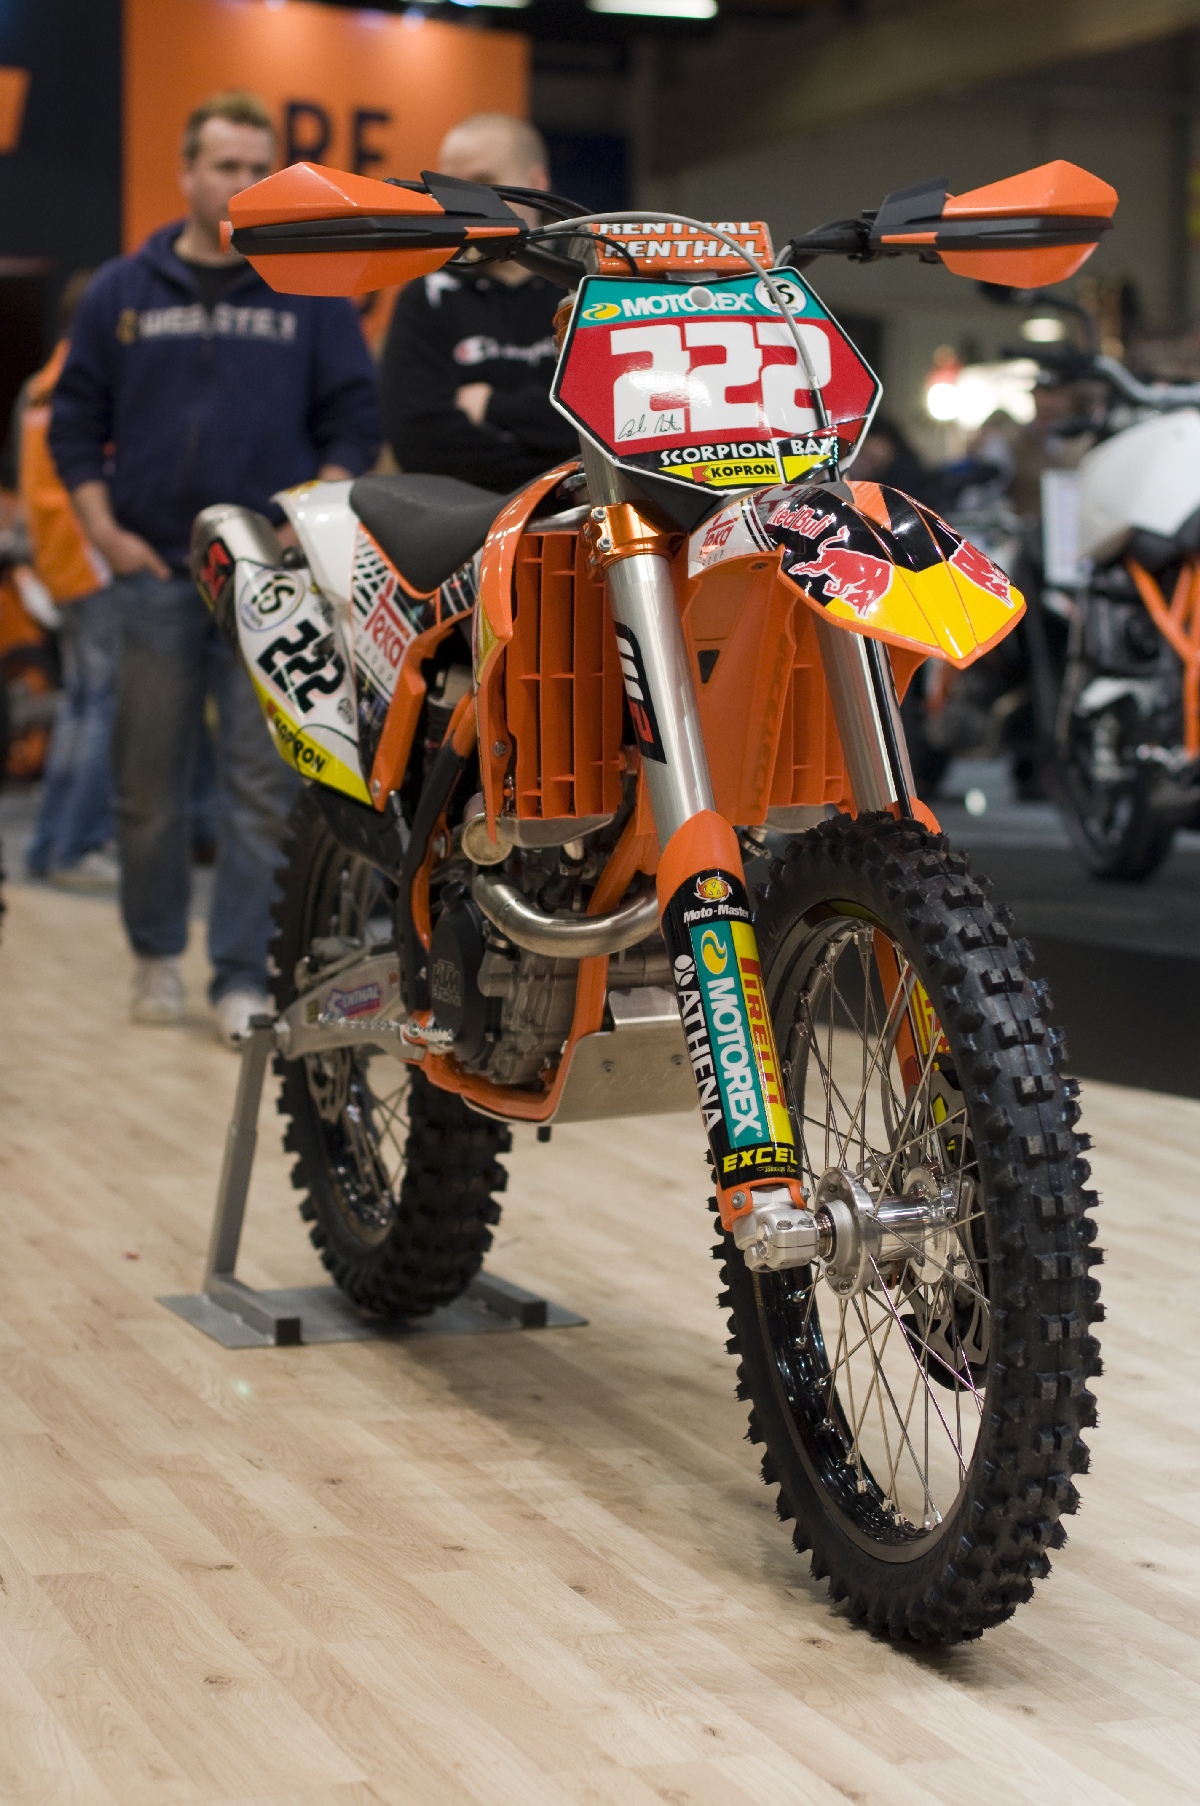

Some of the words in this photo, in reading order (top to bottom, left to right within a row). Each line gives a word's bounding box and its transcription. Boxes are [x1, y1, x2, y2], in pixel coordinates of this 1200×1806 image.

[621, 293, 754, 317] MOTOEX
[610, 321, 832, 442] 222
[661, 441, 776, 466] SCORPION
[791, 438, 833, 455] BAY
[711, 464, 776, 478] KOPRON
[257, 619, 346, 714] 222
[683, 904, 749, 924] Moto-Master
[678, 990, 723, 1137] ATHENA
[707, 976, 762, 1138] MOTOREX
[740, 957, 787, 1110] PIRELLI
[722, 1147, 798, 1173] EXCEL
